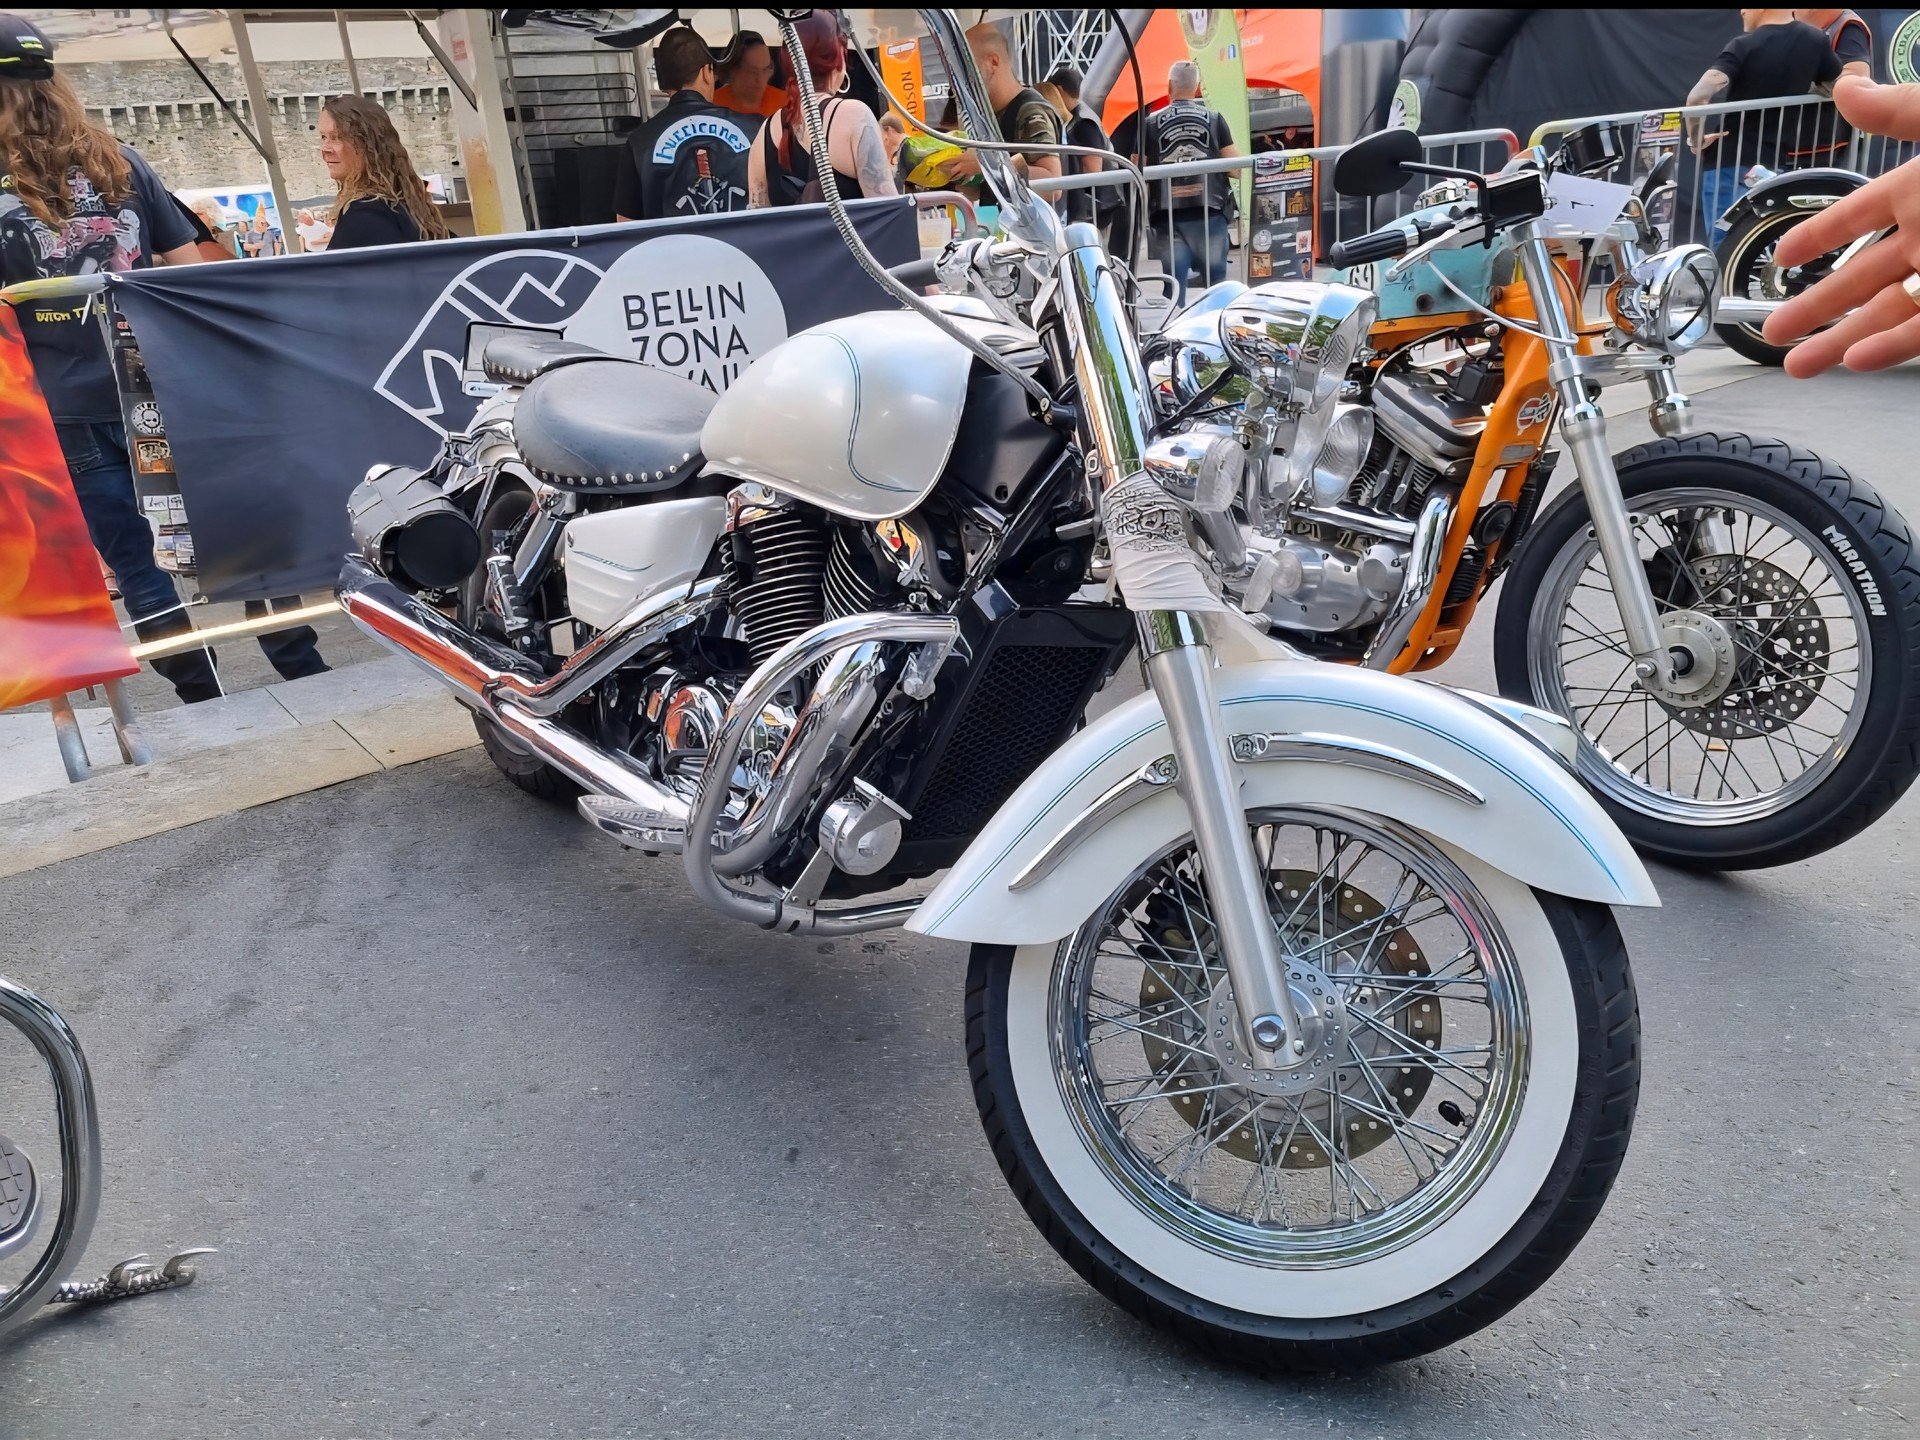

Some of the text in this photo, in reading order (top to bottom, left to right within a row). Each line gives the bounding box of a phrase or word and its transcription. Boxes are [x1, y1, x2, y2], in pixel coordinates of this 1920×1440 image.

[622, 281, 746, 331] BELLIN
[631, 324, 750, 367] ZONA
[1822, 524, 1888, 616] MARATHON
